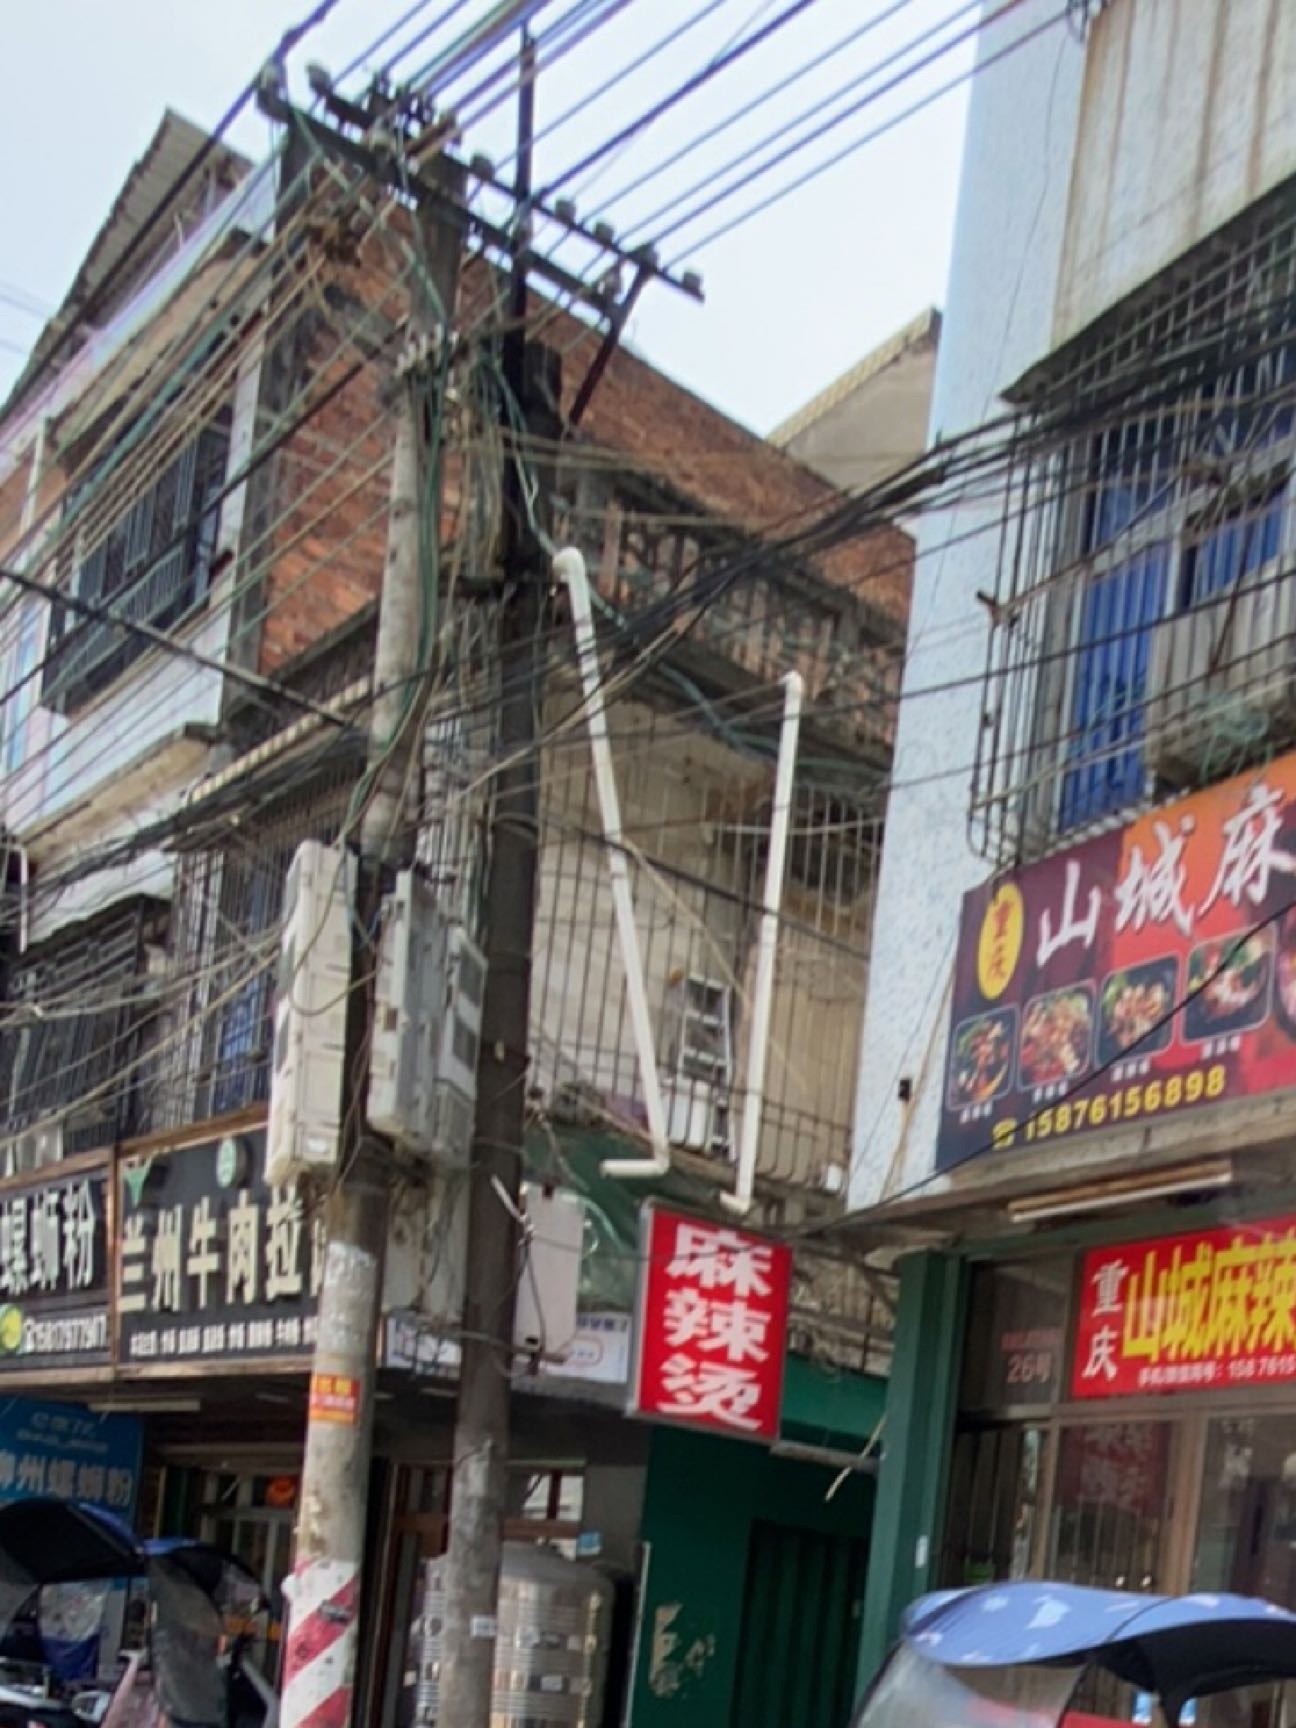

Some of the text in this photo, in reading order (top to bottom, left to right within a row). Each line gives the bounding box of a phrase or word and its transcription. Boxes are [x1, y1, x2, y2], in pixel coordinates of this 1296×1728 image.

[1024, 1064, 1226, 1141] 15876156898
[656, 1222, 773, 1431] 麻辣烫
[1082, 1258, 1129, 1381] 重庆
